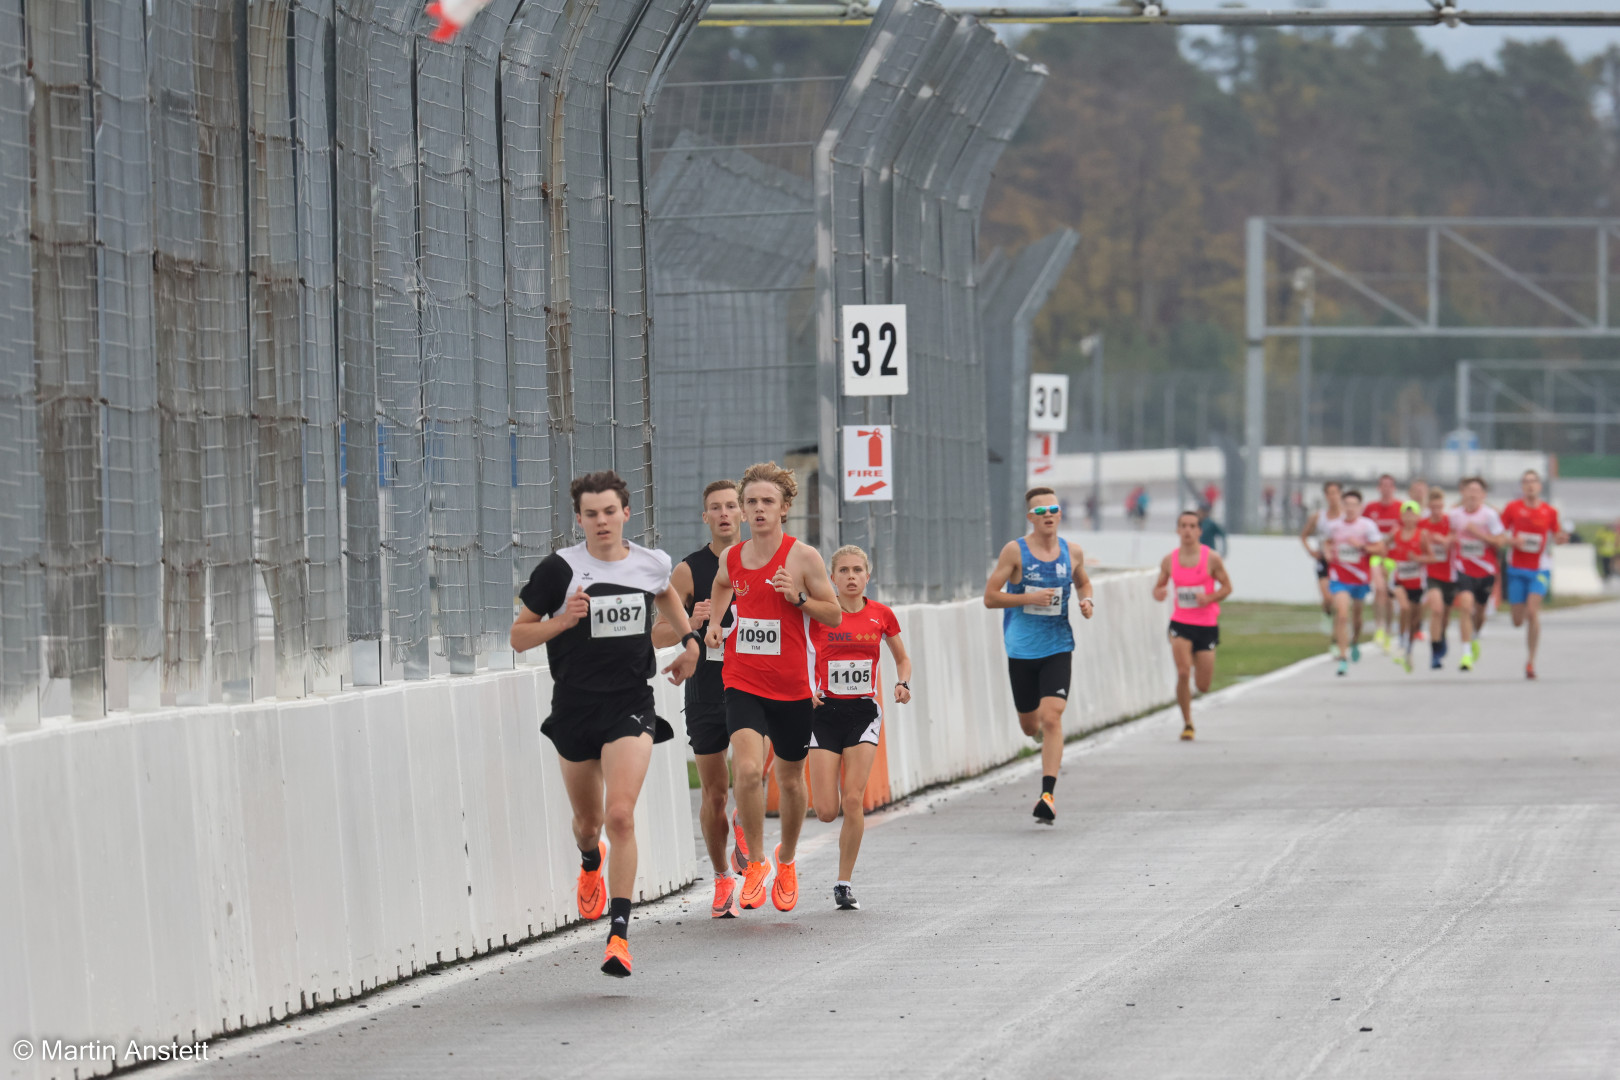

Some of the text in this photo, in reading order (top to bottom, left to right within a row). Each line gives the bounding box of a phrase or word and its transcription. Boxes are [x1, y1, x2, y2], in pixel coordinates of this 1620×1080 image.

[851, 321, 898, 377] 32
[1035, 386, 1062, 419] 30
[847, 469, 884, 478] FIRE
[594, 606, 642, 624] 1087
[739, 628, 777, 643] 1090
[827, 632, 853, 641] SWE
[831, 670, 870, 684] 1105
